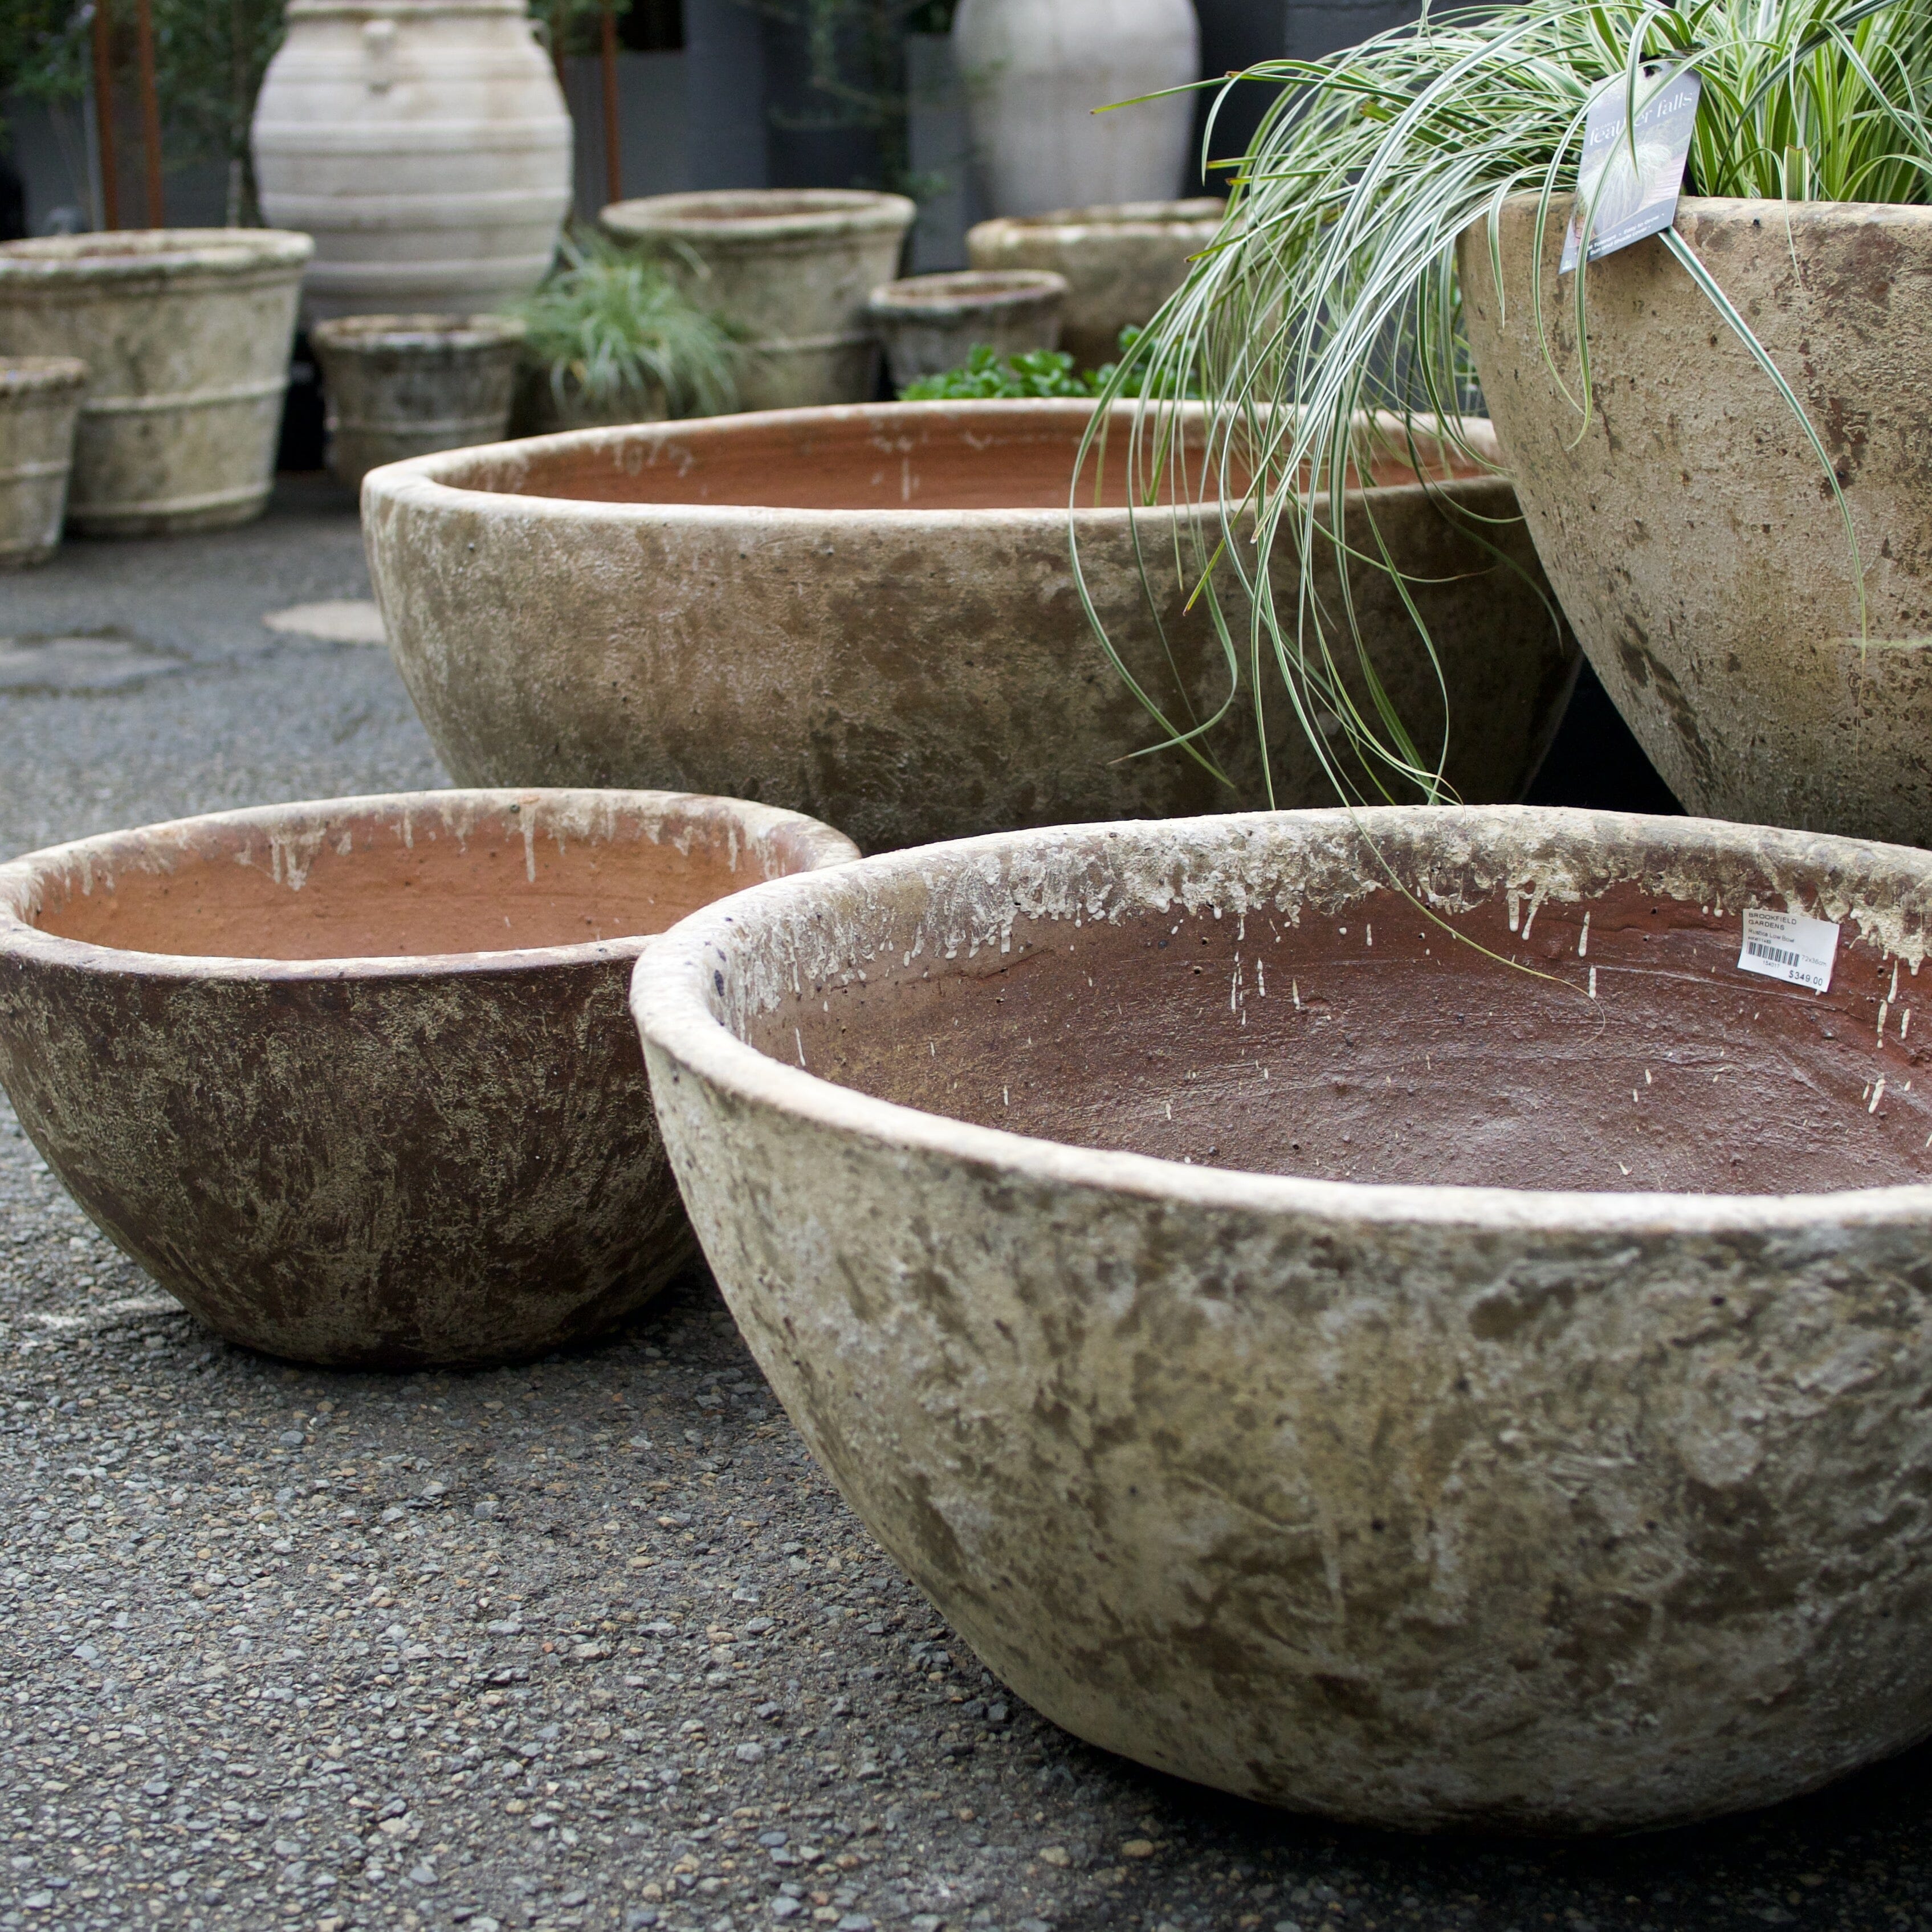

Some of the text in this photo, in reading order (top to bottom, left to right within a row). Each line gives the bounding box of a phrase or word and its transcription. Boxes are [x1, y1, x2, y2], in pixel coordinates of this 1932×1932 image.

[1589, 92, 1693, 145] feater falls
[1624, 225, 1637, 235] Easy
[1601, 242, 1613, 251] and
[1748, 912, 1797, 925] BROOKFIELD
[1748, 919, 1785, 930] GARDENS
[1788, 970, 1823, 986] $349.00
